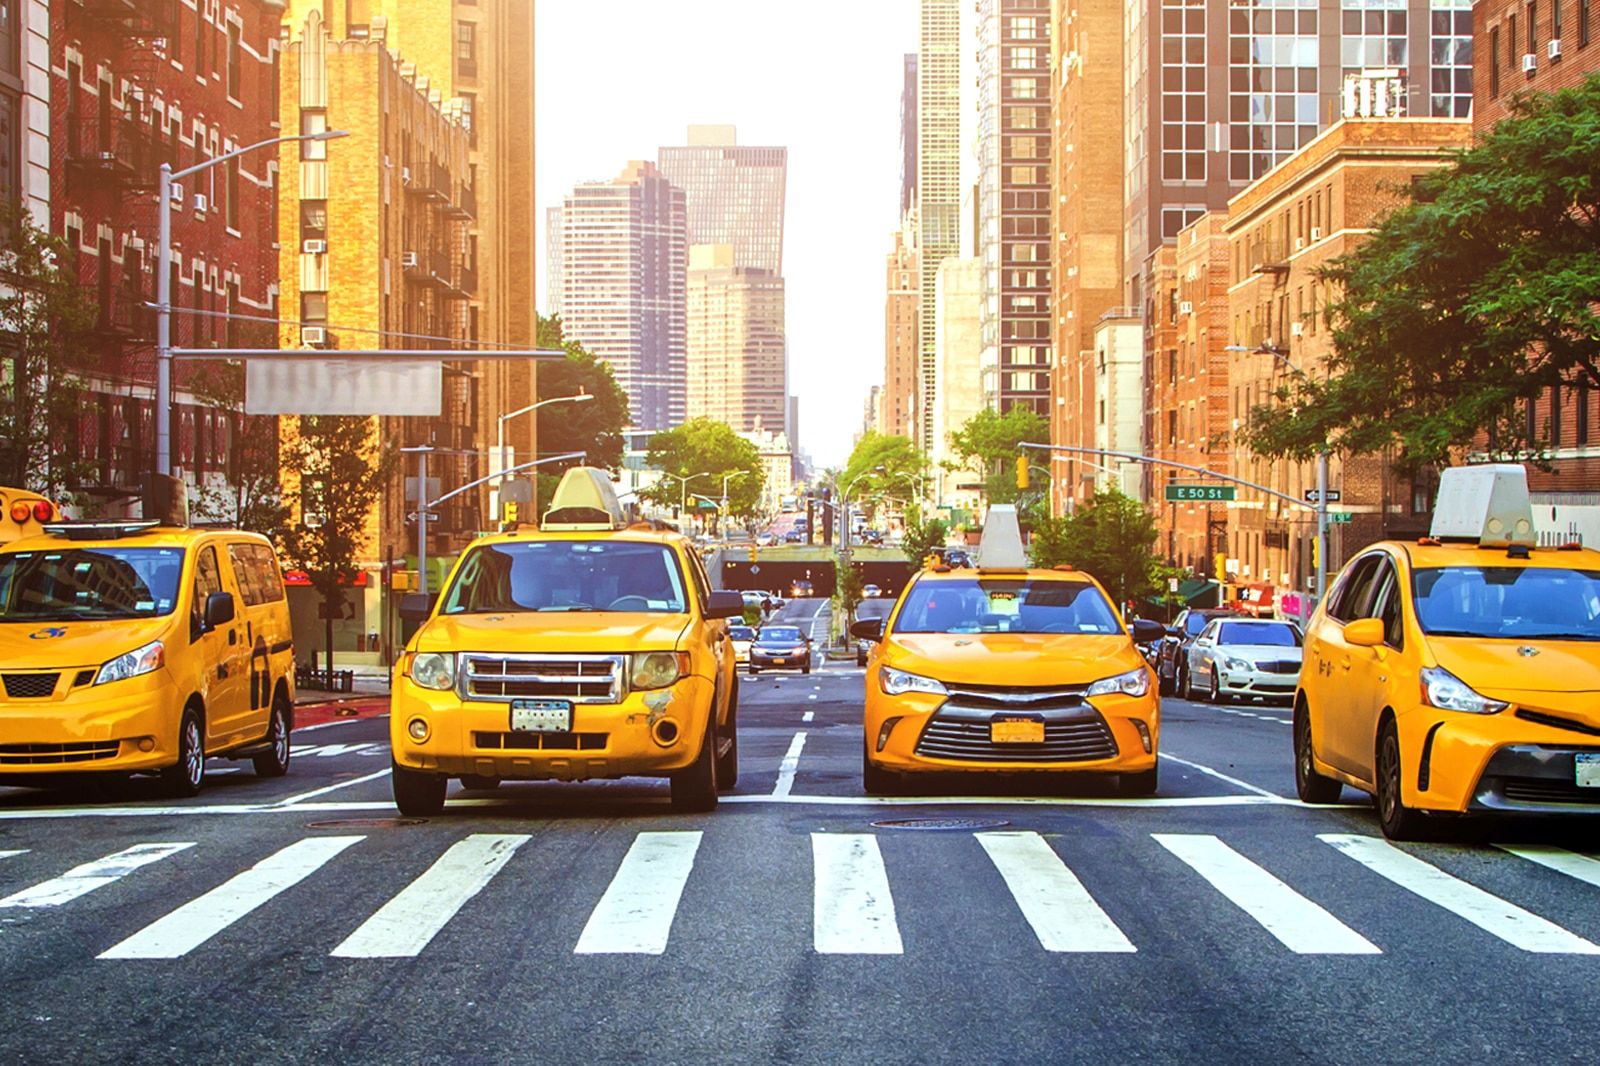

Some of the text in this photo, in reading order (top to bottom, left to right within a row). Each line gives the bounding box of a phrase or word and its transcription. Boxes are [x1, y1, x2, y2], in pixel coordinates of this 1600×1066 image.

[1177, 488, 1222, 499] E 50 St
